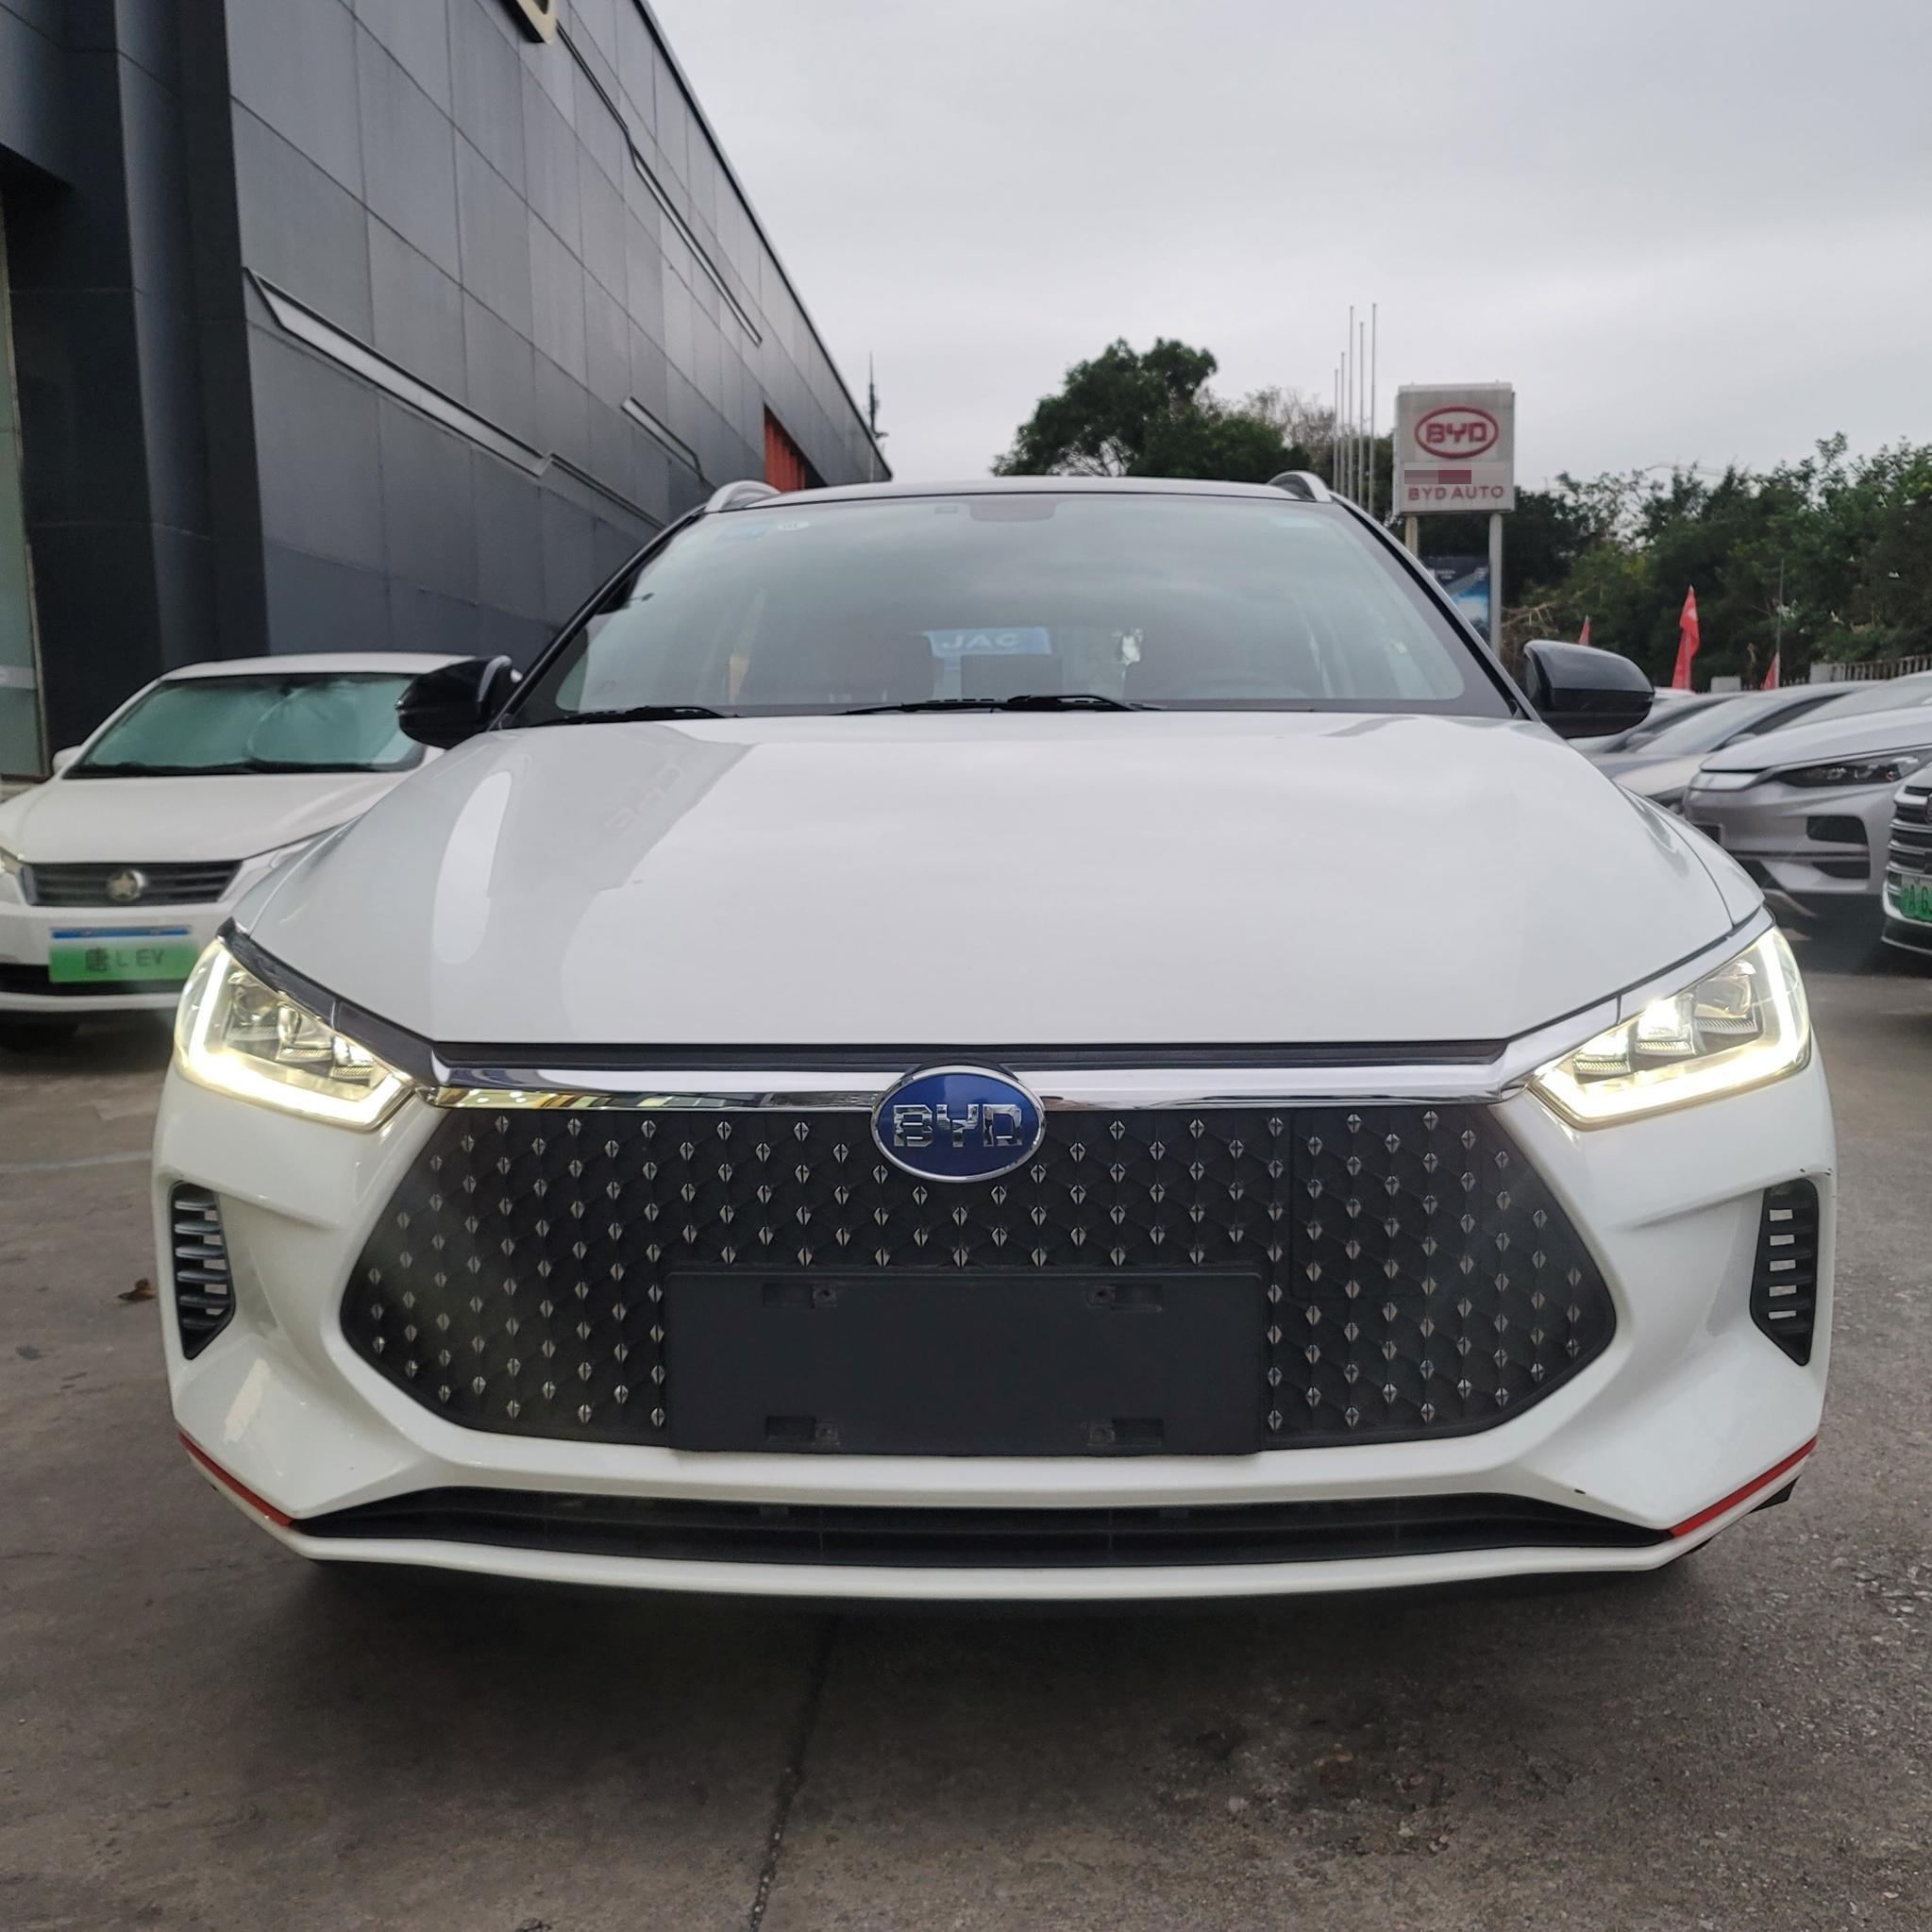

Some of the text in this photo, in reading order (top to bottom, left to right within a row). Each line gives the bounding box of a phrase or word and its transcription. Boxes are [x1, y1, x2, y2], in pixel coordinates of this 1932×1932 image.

[1426, 422, 1487, 444] BYD
[1408, 485, 1504, 501] BYD AUTO
[893, 1104, 1023, 1148] BYD
